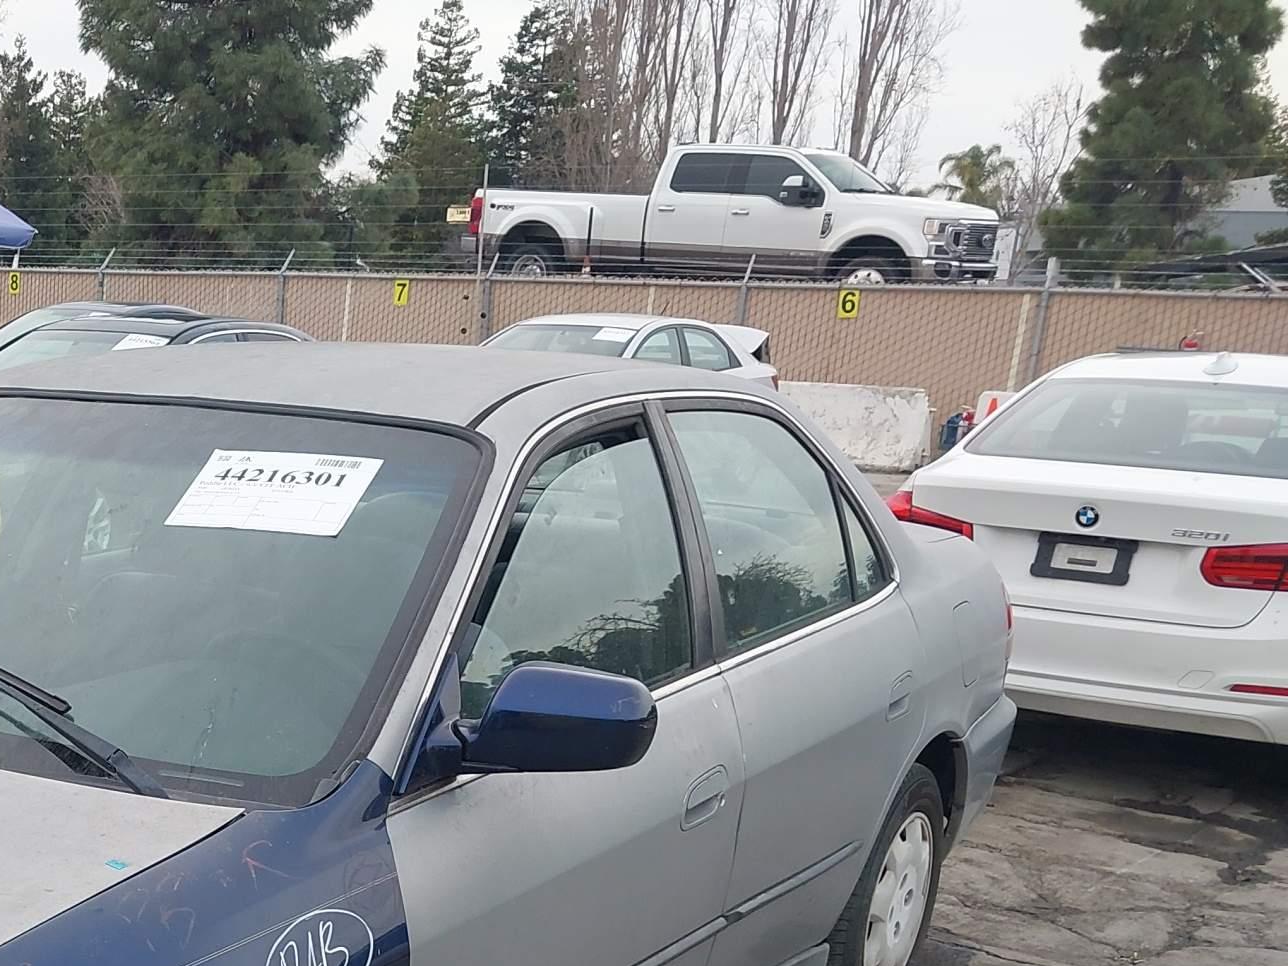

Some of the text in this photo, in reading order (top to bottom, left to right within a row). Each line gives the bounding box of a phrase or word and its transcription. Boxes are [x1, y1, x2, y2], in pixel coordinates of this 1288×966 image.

[10, 273, 18, 291] 8
[396, 283, 407, 302] 7
[841, 291, 856, 314] 6
[214, 467, 348, 488] 44216301
[1171, 528, 1230, 542] 320i
